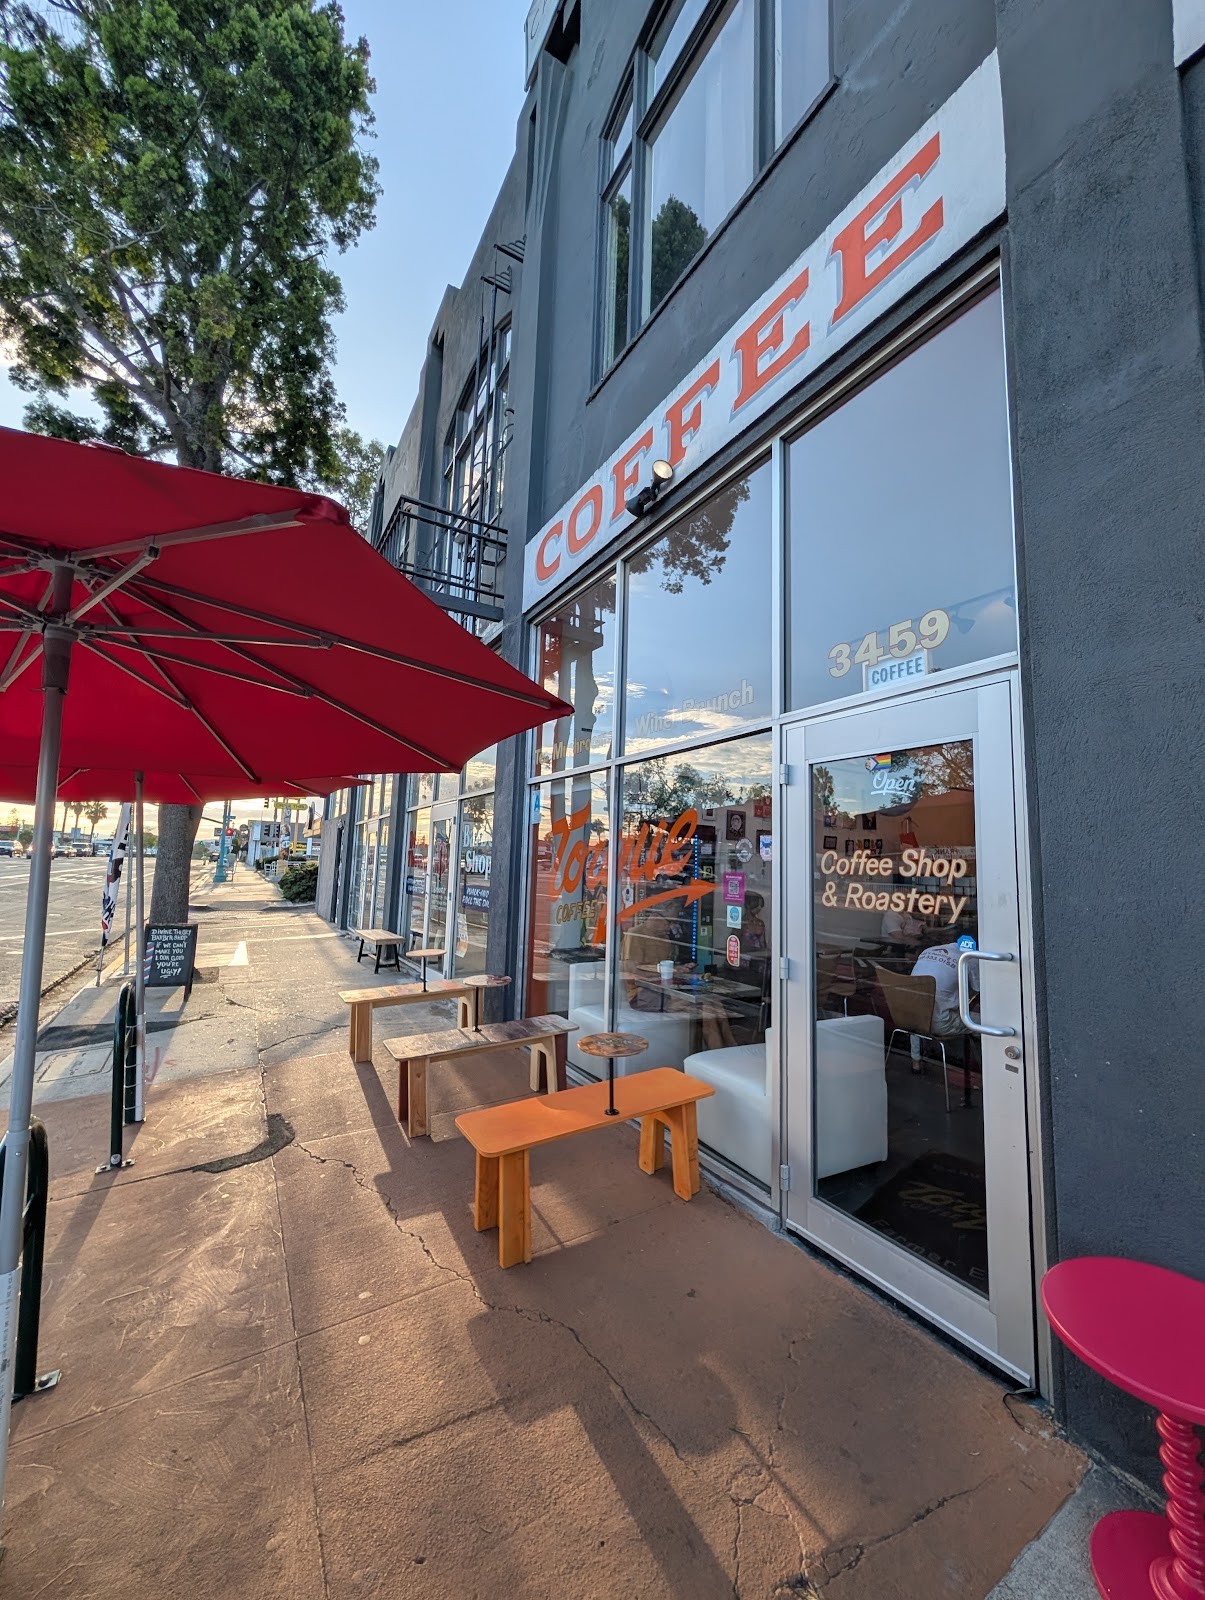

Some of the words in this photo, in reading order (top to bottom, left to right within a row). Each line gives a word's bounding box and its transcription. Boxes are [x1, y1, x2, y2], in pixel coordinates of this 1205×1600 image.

[534, 131, 944, 583] COFFEE
[828, 608, 950, 679] 3459
[871, 656, 923, 685] COFFEE
[872, 770, 916, 796] Open
[820, 849, 893, 876] Coffee
[899, 848, 968, 885] Shop
[821, 881, 838, 907] &
[844, 883, 969, 924] Roastery
[960, 940, 974, 949] ADT
